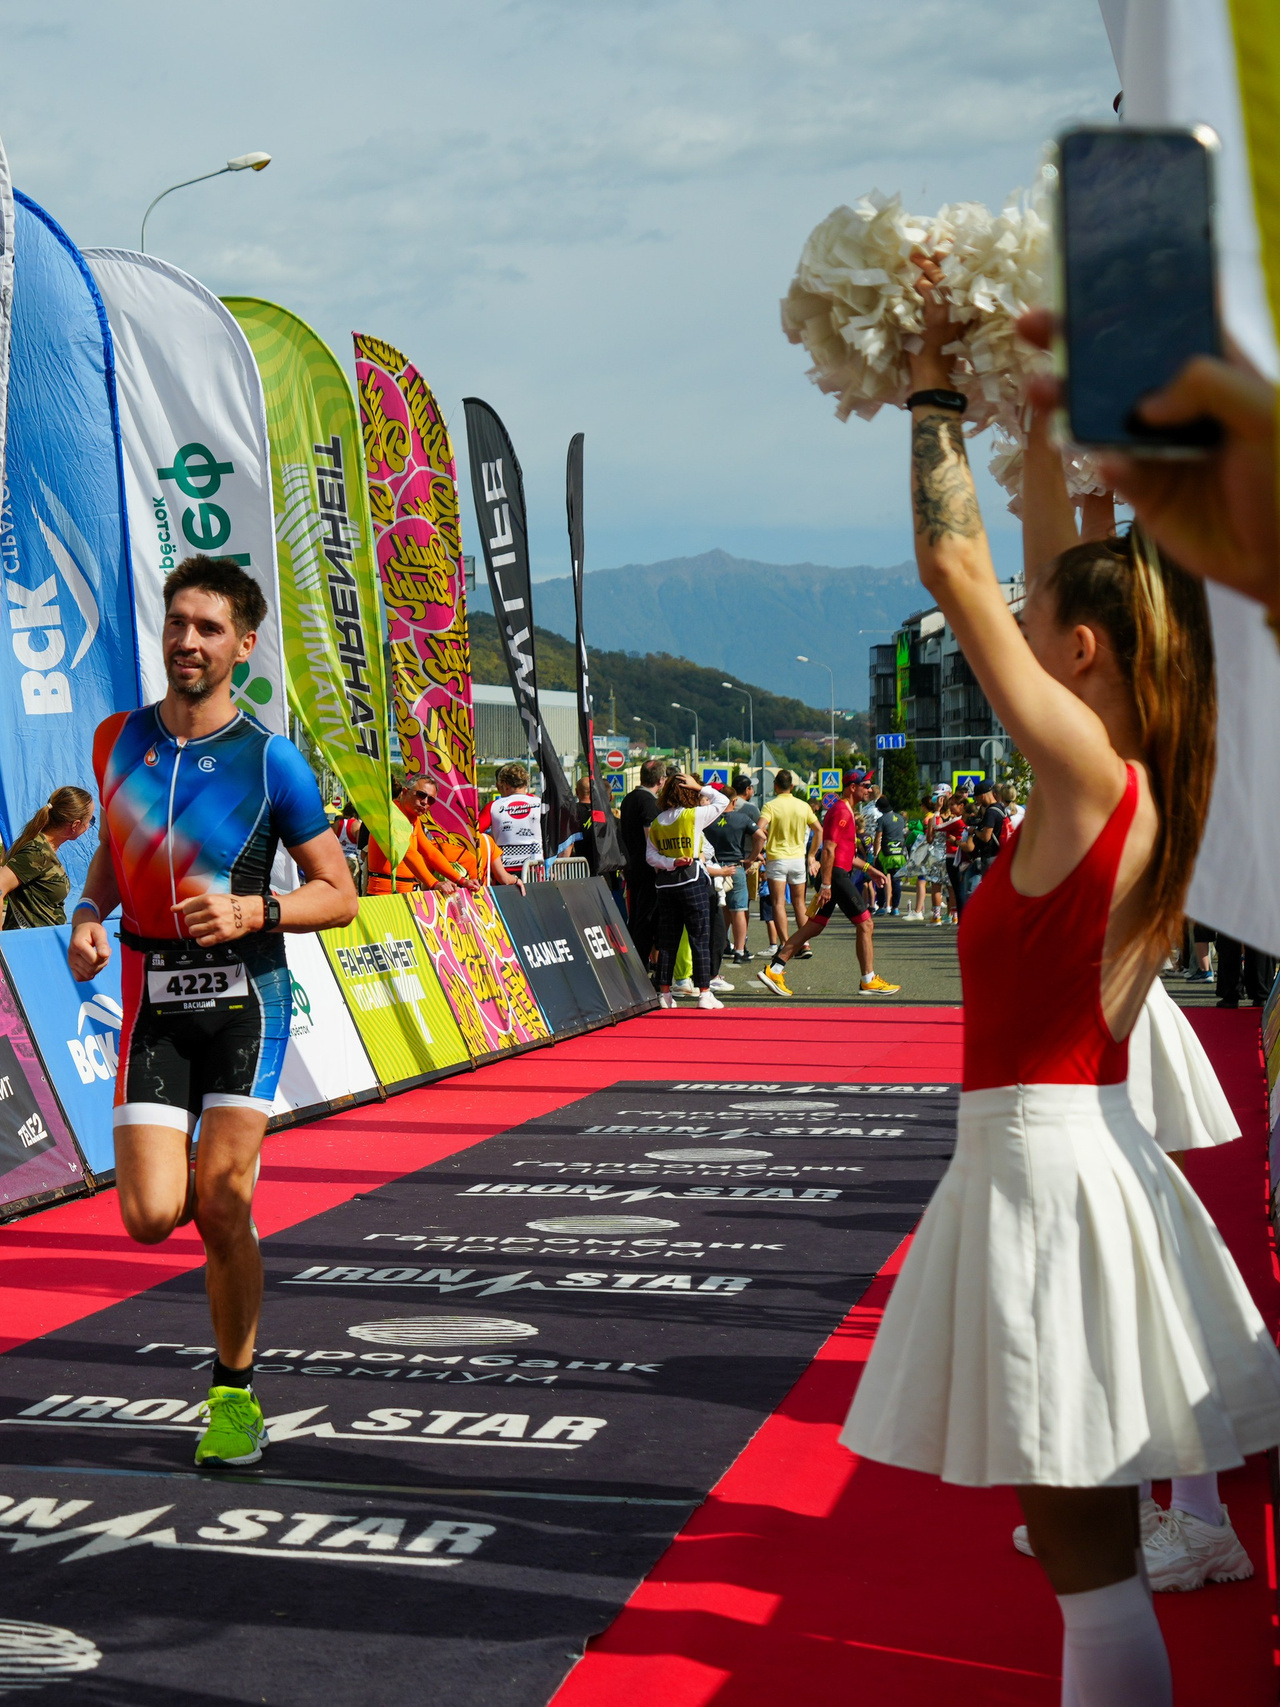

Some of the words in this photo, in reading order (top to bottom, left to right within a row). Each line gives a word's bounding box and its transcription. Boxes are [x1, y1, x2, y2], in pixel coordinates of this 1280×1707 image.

[230, 898, 243, 929] 4223
[335, 938, 419, 979] FAHRENHEIT
[166, 972, 229, 996] 4223
[183, 998, 216, 1010] ВАСИЛИЙ
[66, 1031, 120, 1085] ВСК
[670, 1083, 782, 1091] IRON
[833, 1085, 950, 1093] STAR
[17, 1112, 48, 1148] TELE2
[584, 1125, 710, 1134] IRON
[769, 1127, 905, 1137] STAR
[512, 1160, 866, 1172] Газпромбанк
[464, 1183, 613, 1195] IRON
[681, 1186, 845, 1200] STAR
[362, 1232, 788, 1252] Газпромбанк
[413, 1243, 707, 1258] Премиум
[292, 1265, 471, 1284] IRON
[555, 1271, 754, 1292] STAR
[135, 1343, 666, 1375] Гапромбанк
[350, 1408, 608, 1442] STAR
[195, 1508, 499, 1555] STAR
